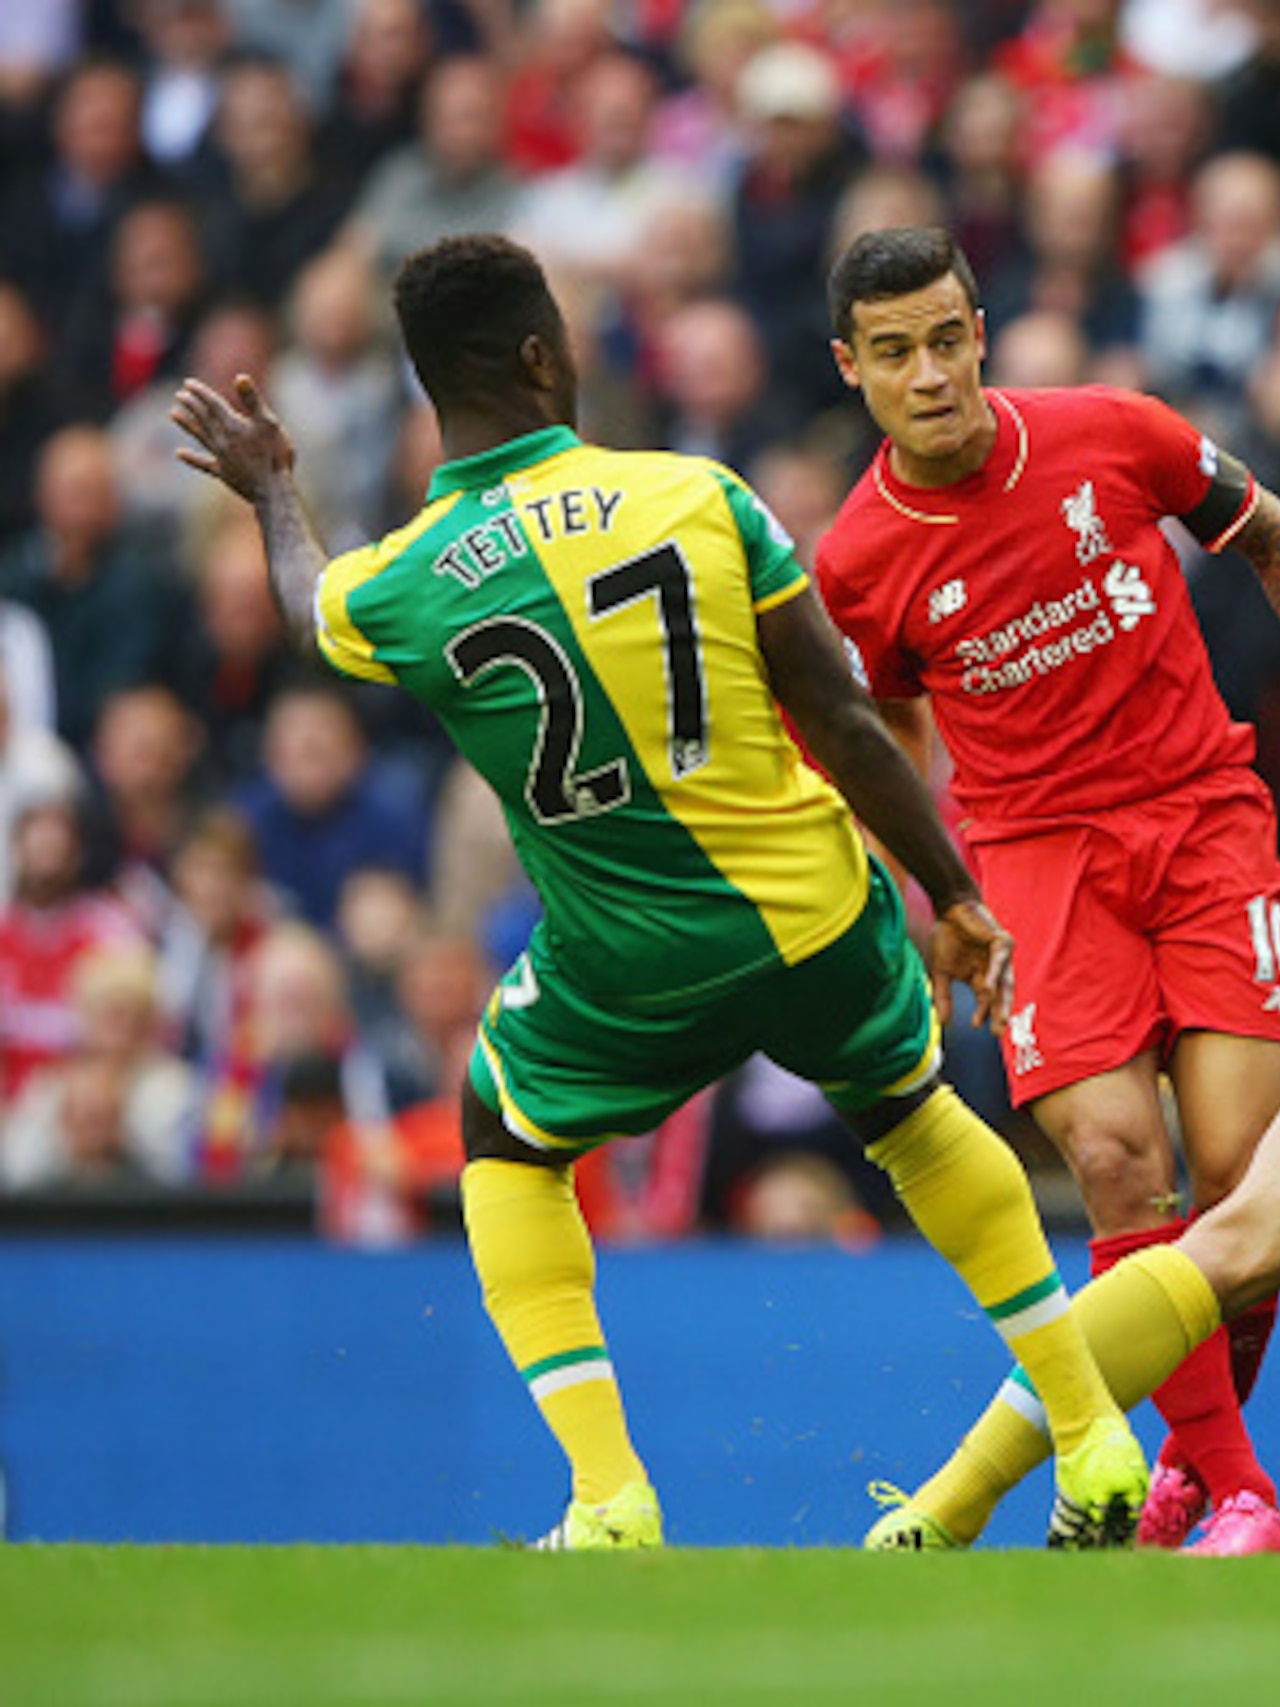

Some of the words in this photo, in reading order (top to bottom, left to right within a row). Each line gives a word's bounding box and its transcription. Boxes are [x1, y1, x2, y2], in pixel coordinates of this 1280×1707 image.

[432, 488, 624, 589] TETTEY
[956, 579, 1098, 665] Standard
[962, 610, 1114, 692] Chartered
[443, 538, 711, 826] 27
